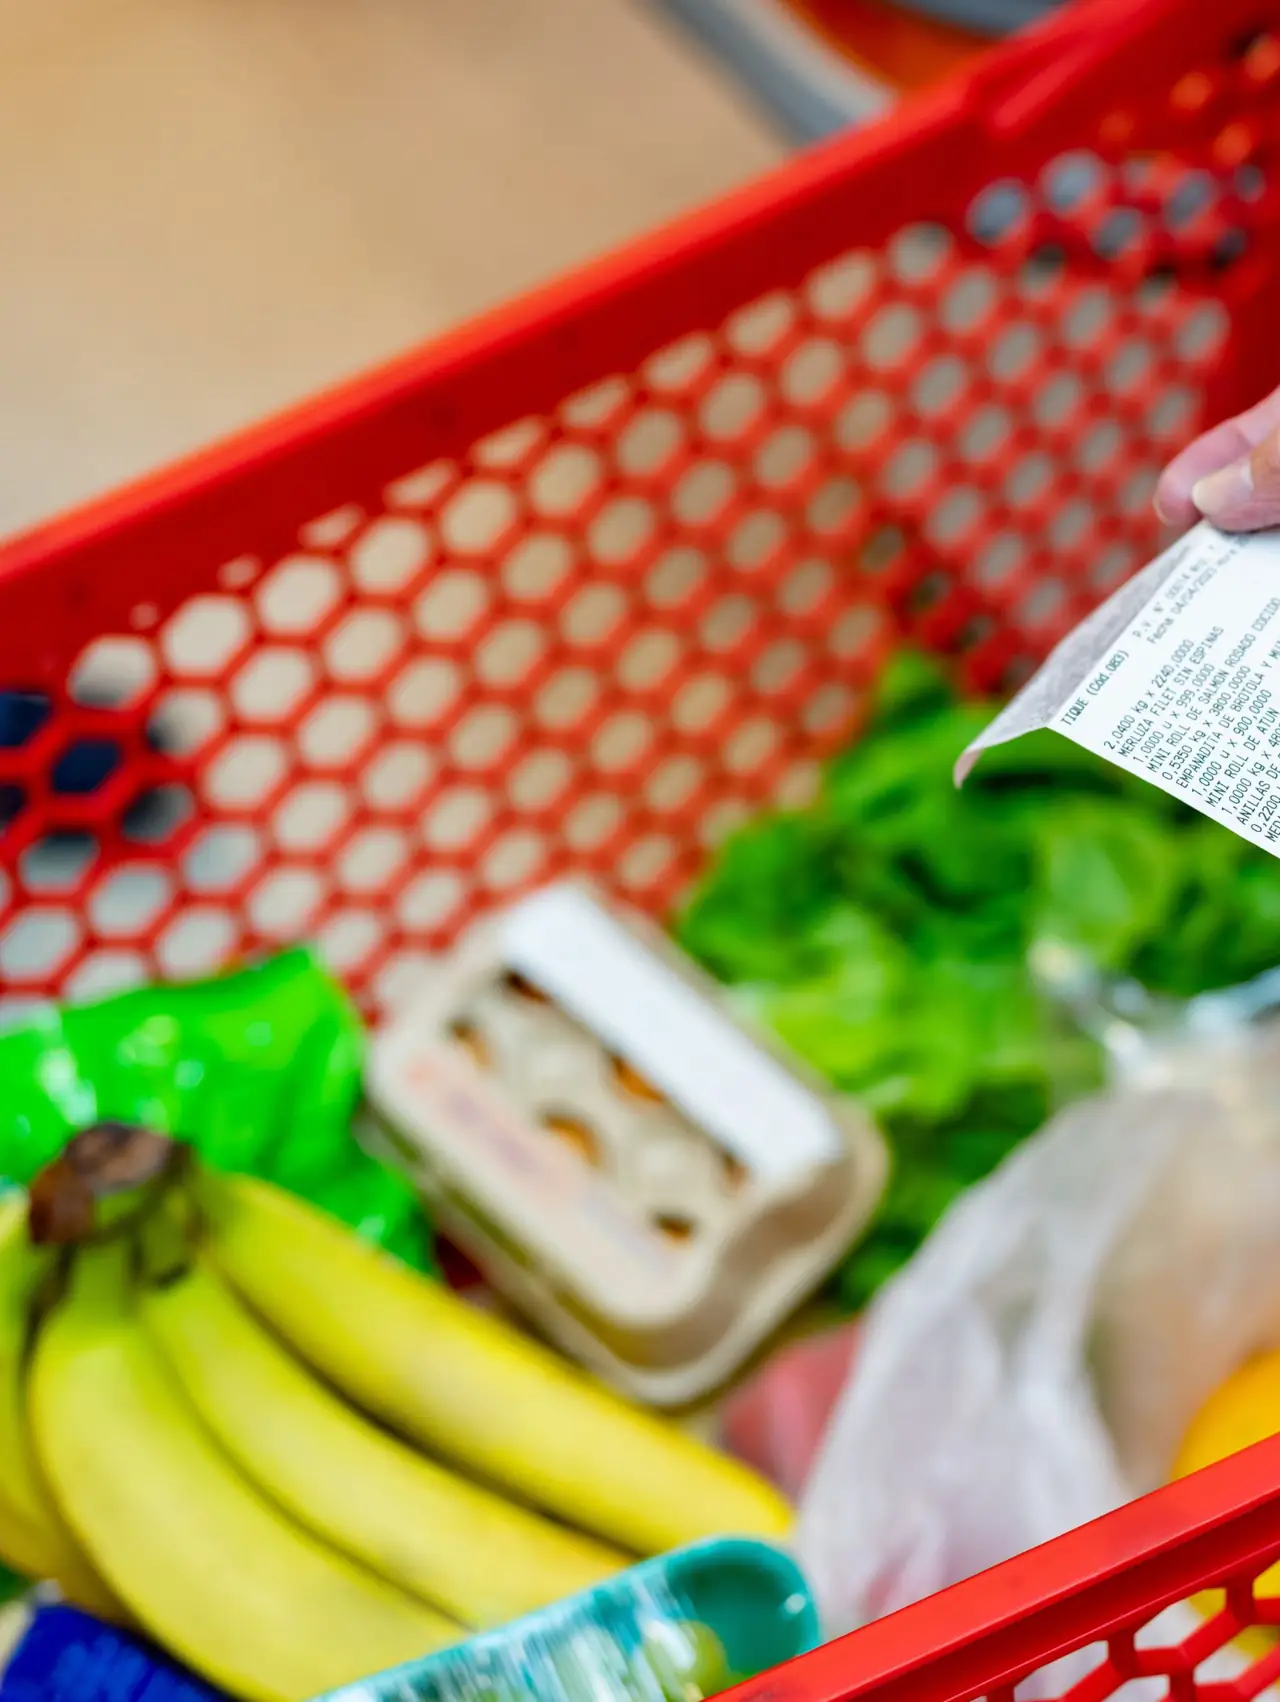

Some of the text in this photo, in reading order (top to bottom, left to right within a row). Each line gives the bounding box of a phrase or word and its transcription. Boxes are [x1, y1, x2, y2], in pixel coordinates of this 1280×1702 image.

[1060, 698, 1088, 725] TIQUE
[1103, 639, 1194, 750] 2,0400 kg x 2240,0000
[1117, 626, 1224, 757] MERLUZA FILET SIN ESPINAS
[1132, 730, 1164, 763] 1,0000
[1162, 720, 1173, 730] u
[1170, 710, 1179, 719] x
[1146, 747, 1171, 773] MINI
[1165, 724, 1191, 747] ROLL
[1185, 705, 1203, 721] DE
[1197, 670, 1229, 704] SALMON
[1224, 634, 1256, 667] ROSADO
[1161, 665, 1251, 780] 0,5350 kg x 3800,0000
[1175, 731, 1223, 789] EMPANADITA
[1218, 714, 1235, 729] DE
[1229, 672, 1264, 712] BROTOLA
[1261, 660, 1272, 668] Y
[1191, 688, 1272, 796] 1,0000 u x 900,0000
[1204, 707, 1280, 807] MINI ROLL DE ATUN
[1220, 777, 1252, 814] 1,0000
[1246, 761, 1266, 776] kg
[1260, 750, 1272, 760] x
[1236, 780, 1271, 825] ANILLAS
